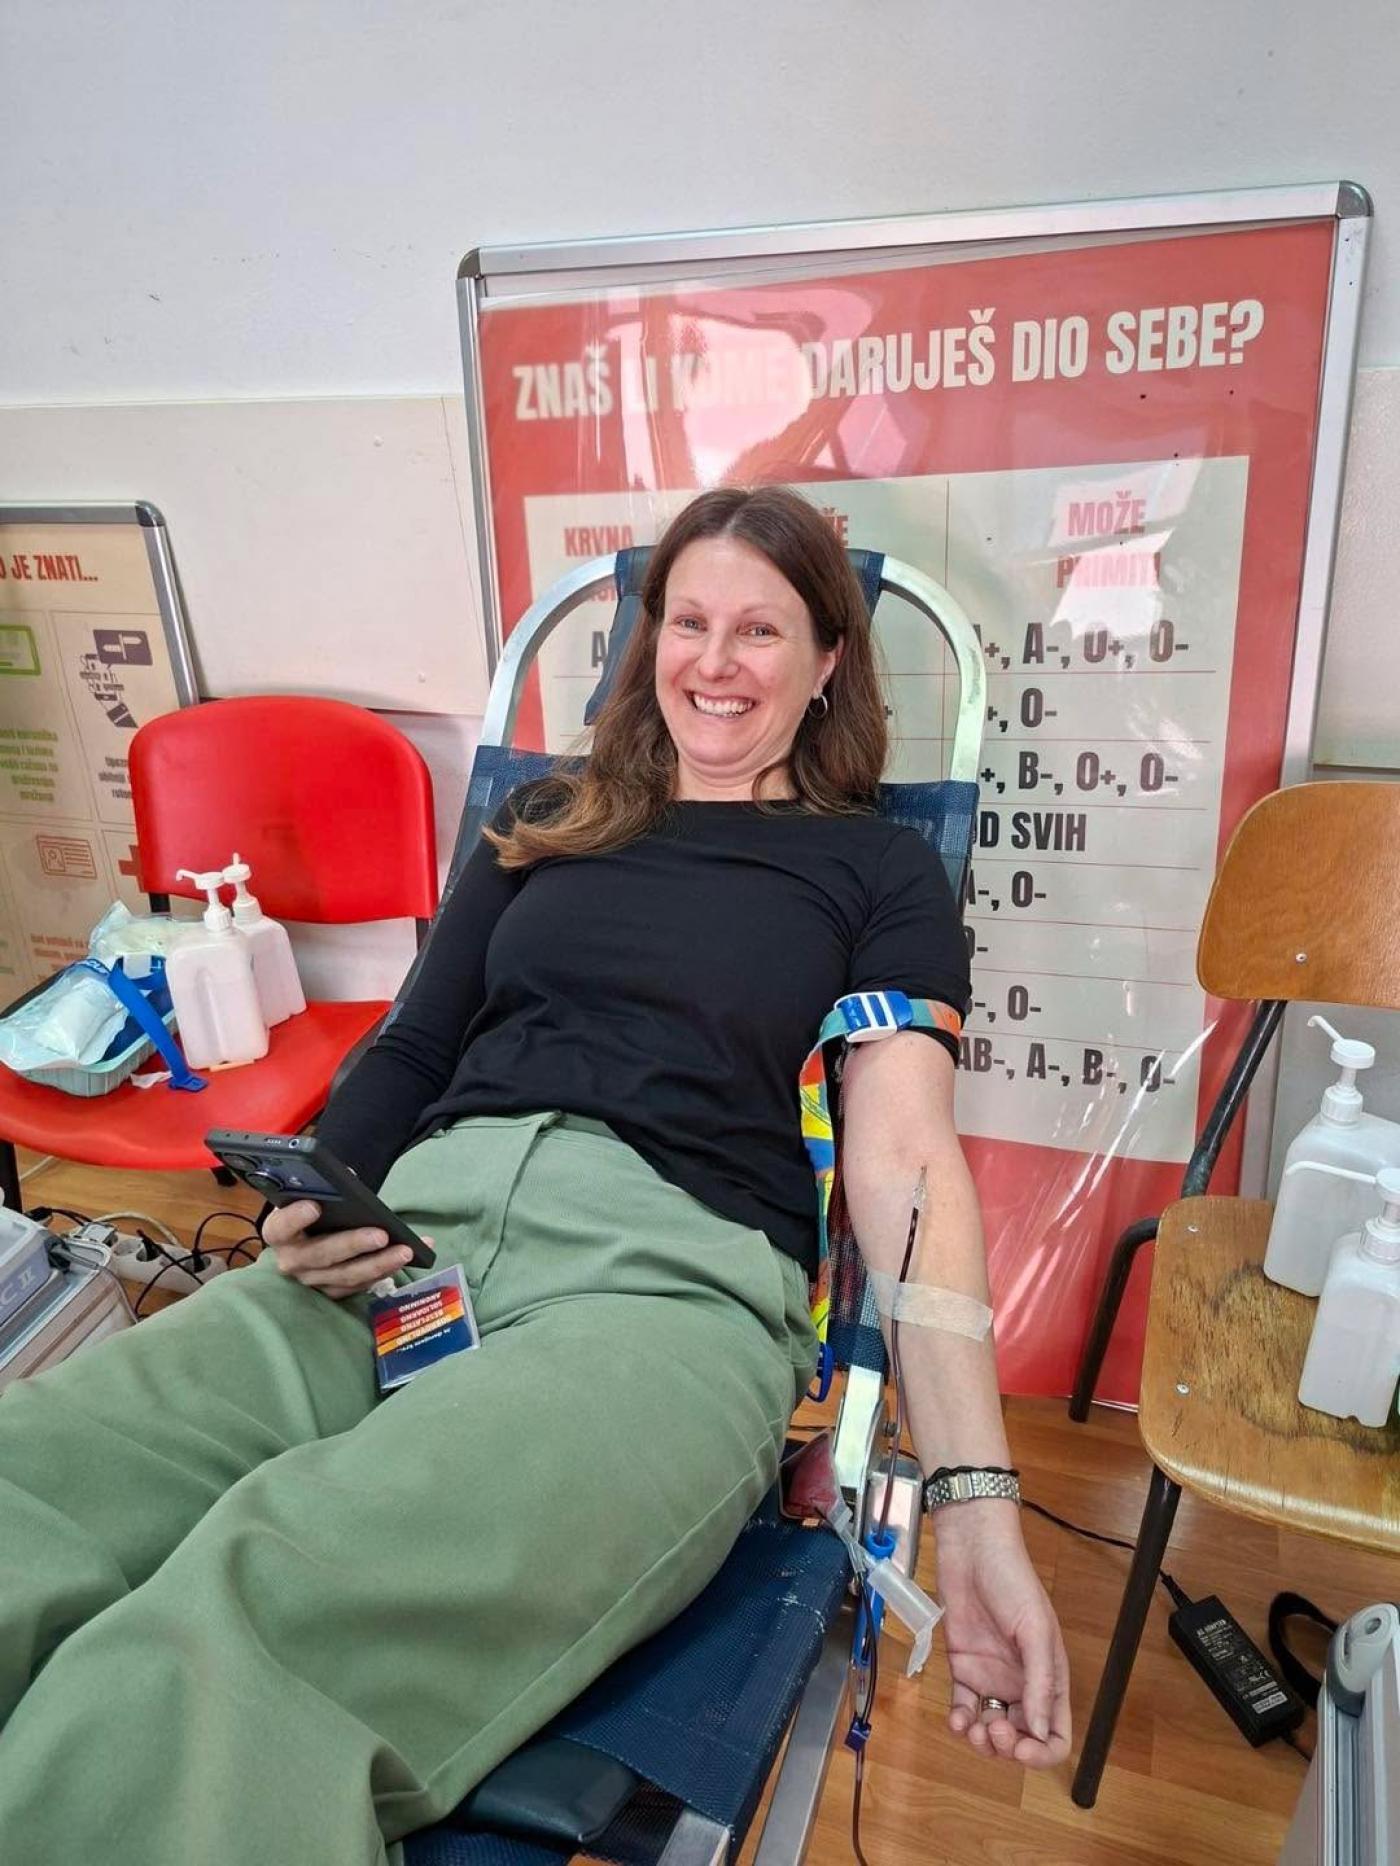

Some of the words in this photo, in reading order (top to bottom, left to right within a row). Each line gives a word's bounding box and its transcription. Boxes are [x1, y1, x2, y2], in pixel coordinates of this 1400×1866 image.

[512, 344, 614, 421] ZNAŠ
[801, 308, 997, 400] DARUJEŠ
[1012, 315, 1090, 383] DIO
[1105, 299, 1266, 375] SEBE?
[1067, 490, 1147, 537] MOŽE
[11, 554, 32, 580] JE
[32, 554, 98, 581] ZNATI...
[1022, 622, 1071, 669] A-,
[1018, 750, 1064, 796] B-,
[972, 810, 1000, 849] D
[1010, 811, 1087, 852] SVIH
[1026, 1042, 1071, 1088] A-,
